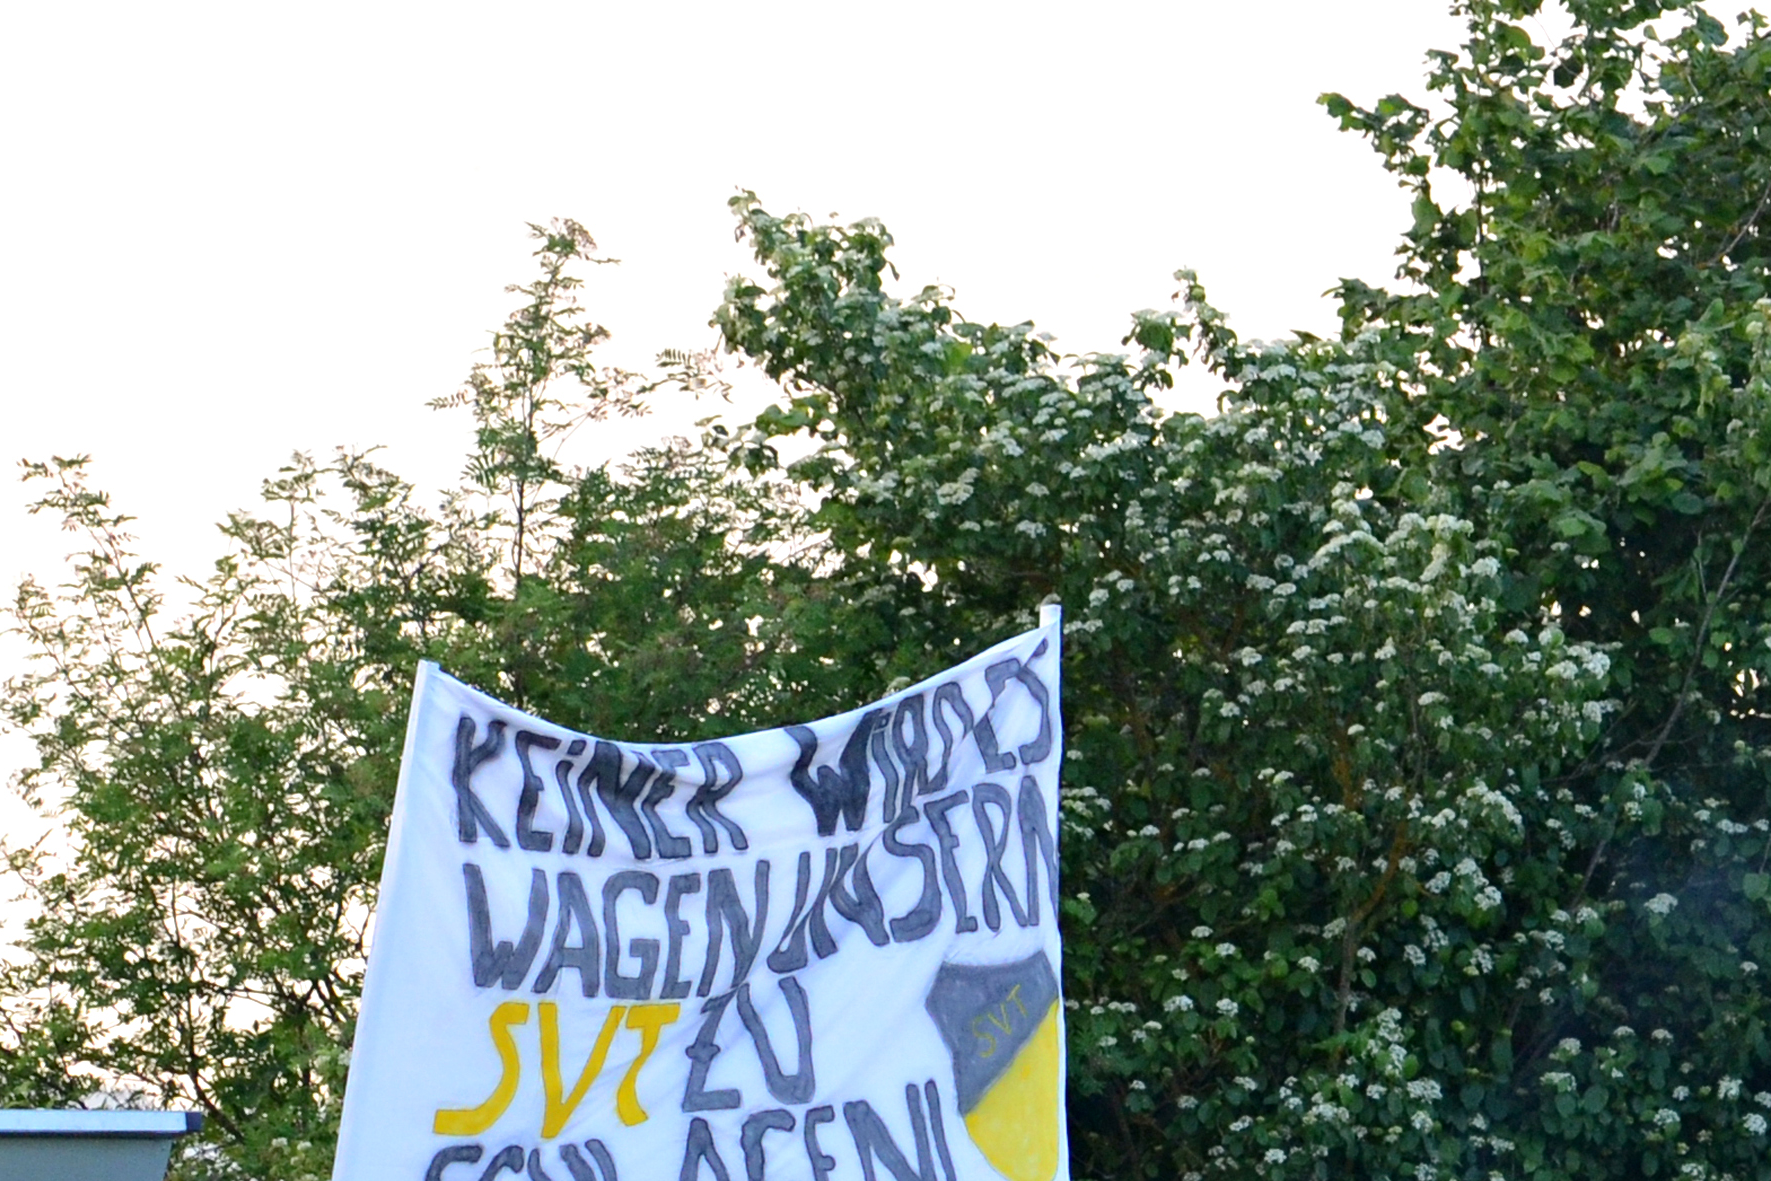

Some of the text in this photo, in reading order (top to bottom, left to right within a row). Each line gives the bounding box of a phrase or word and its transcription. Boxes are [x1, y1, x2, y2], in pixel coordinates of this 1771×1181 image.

[462, 859, 770, 1000] WAGEN
[432, 976, 816, 1138] SVT ZU
[971, 983, 1028, 1058] SVT
